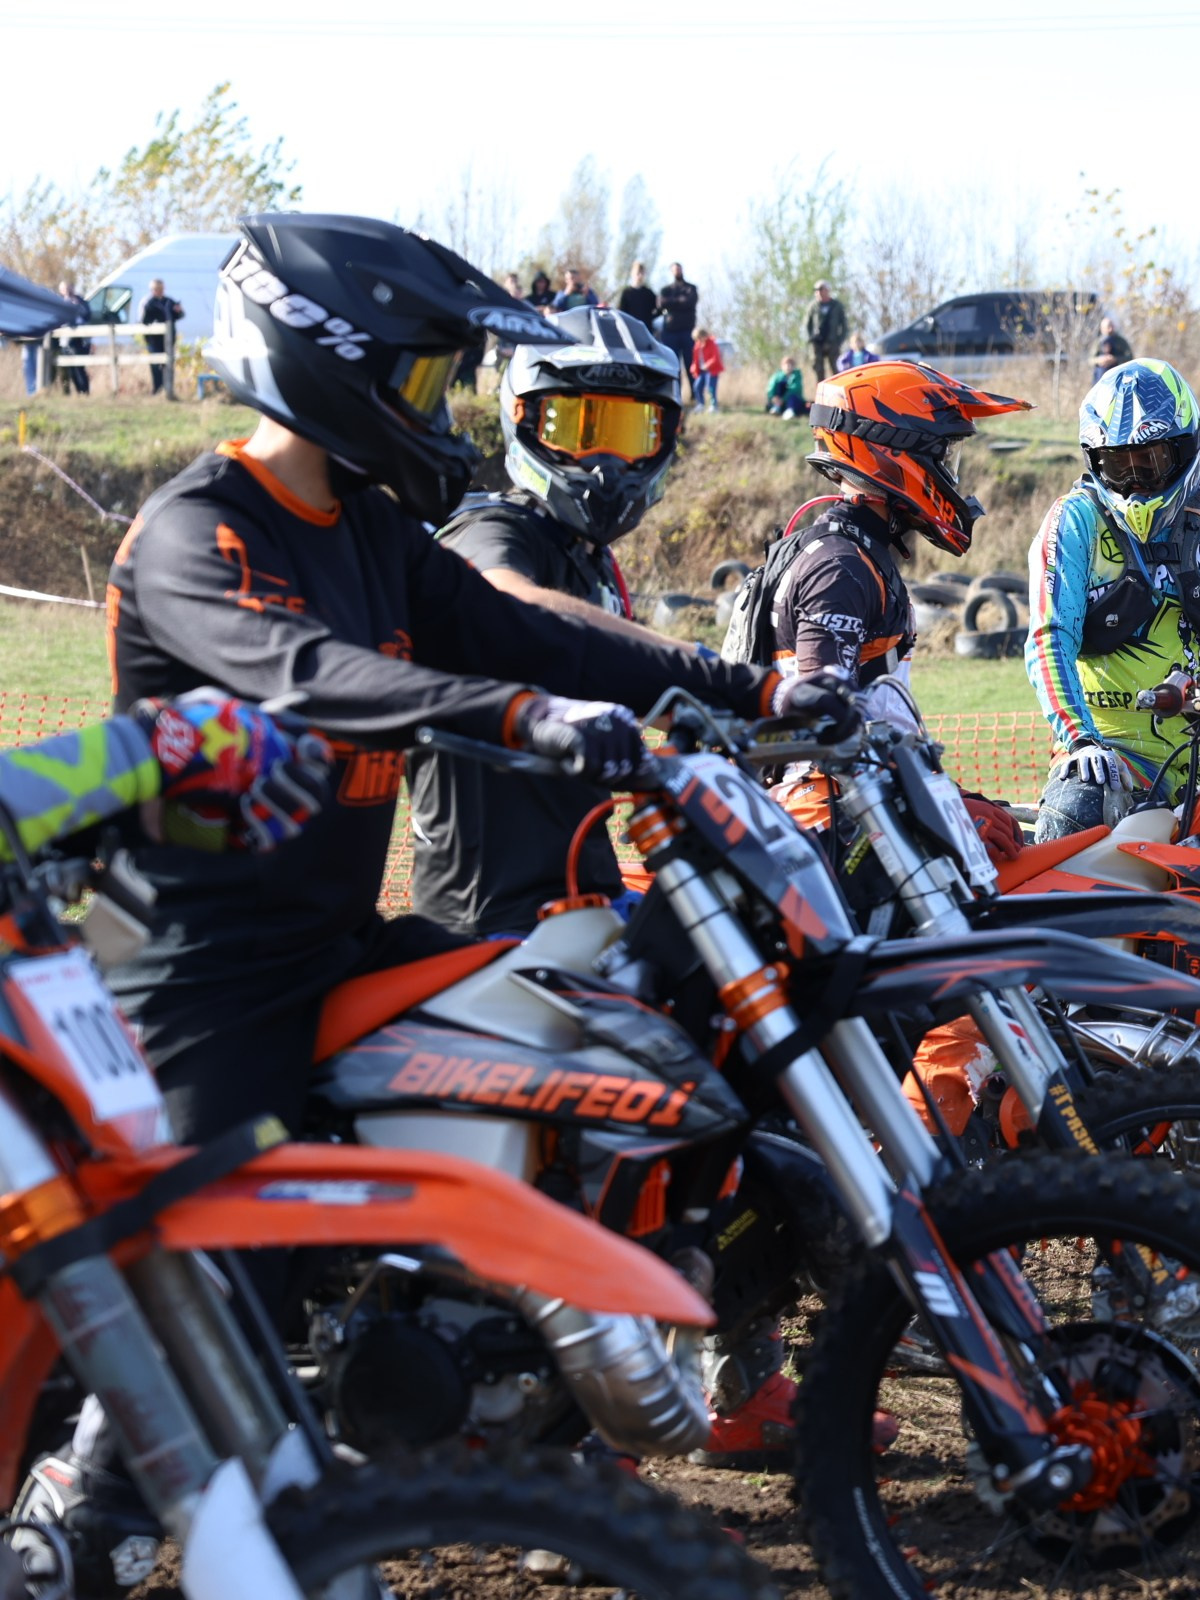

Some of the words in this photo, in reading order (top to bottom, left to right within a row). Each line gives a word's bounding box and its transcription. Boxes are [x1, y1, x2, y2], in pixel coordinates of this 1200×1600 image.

[852, 418, 943, 454] 100%
[1133, 421, 1168, 444] Airoh
[715, 774, 786, 845] 2
